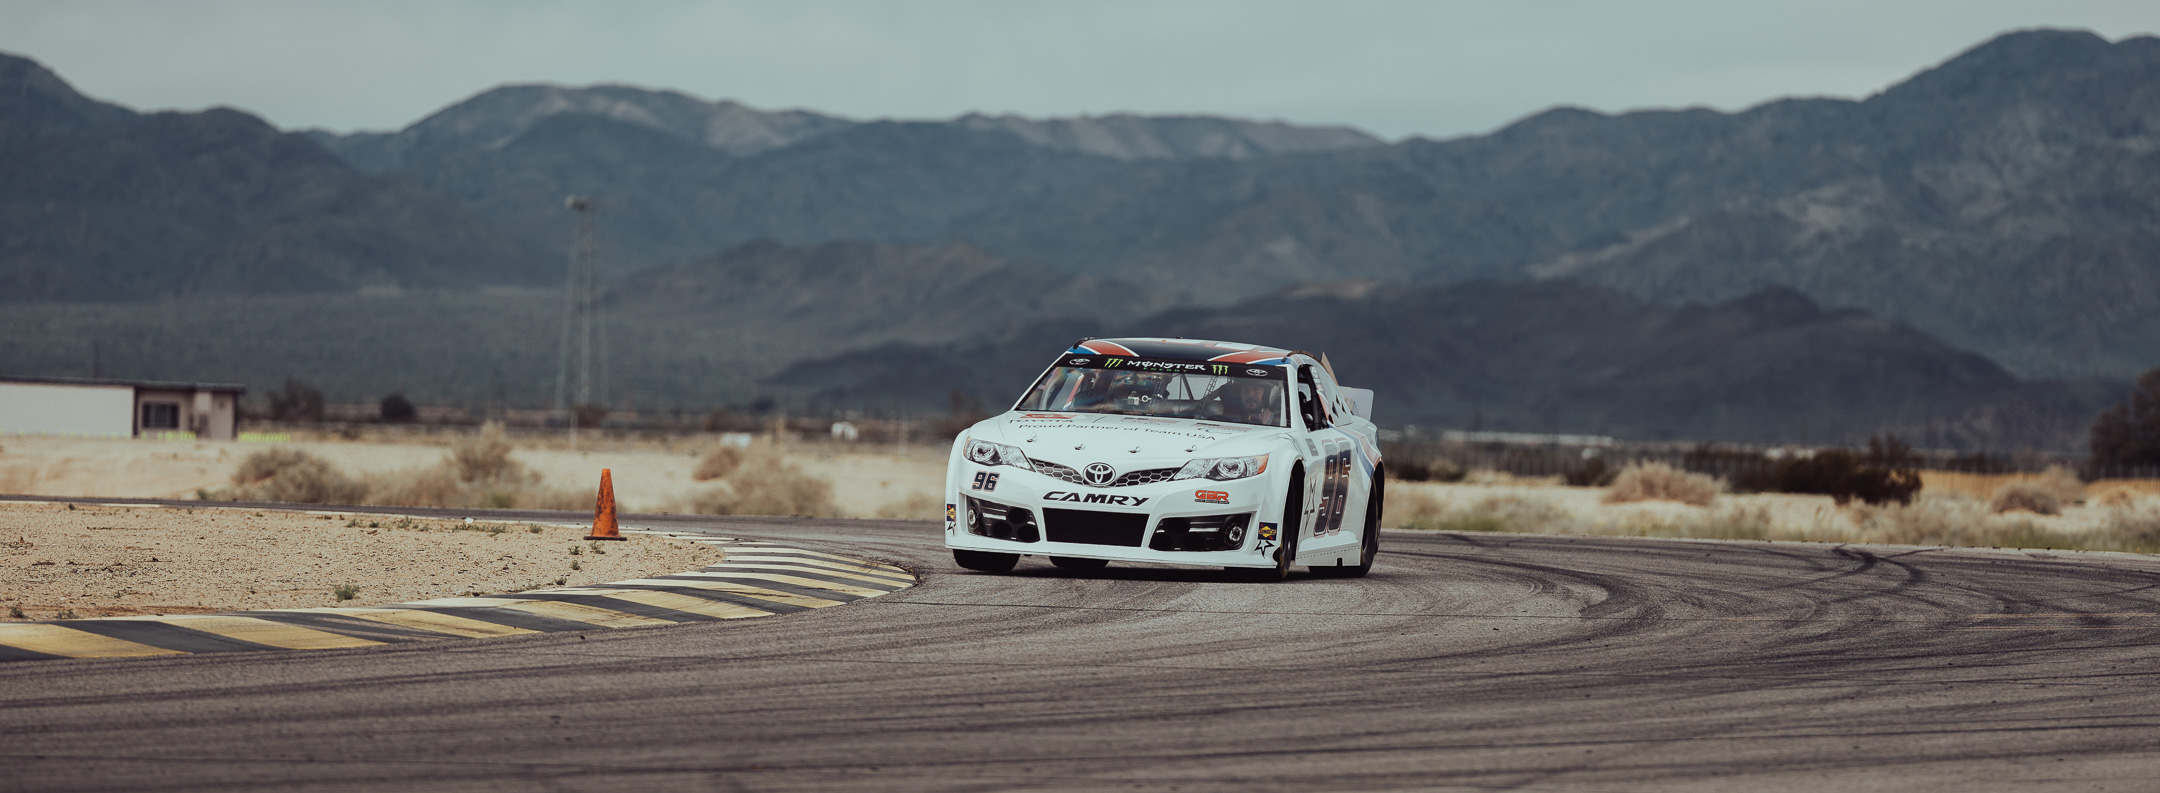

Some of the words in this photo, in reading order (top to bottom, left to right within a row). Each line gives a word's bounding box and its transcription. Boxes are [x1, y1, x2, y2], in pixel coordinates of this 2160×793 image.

[1127, 360, 1206, 371] MONSTER
[1145, 428, 1181, 436] Team
[1186, 432, 1216, 441] USA
[971, 470, 1000, 493] 96
[1042, 491, 1150, 507] CAMRY
[1195, 489, 1229, 502] GBR
